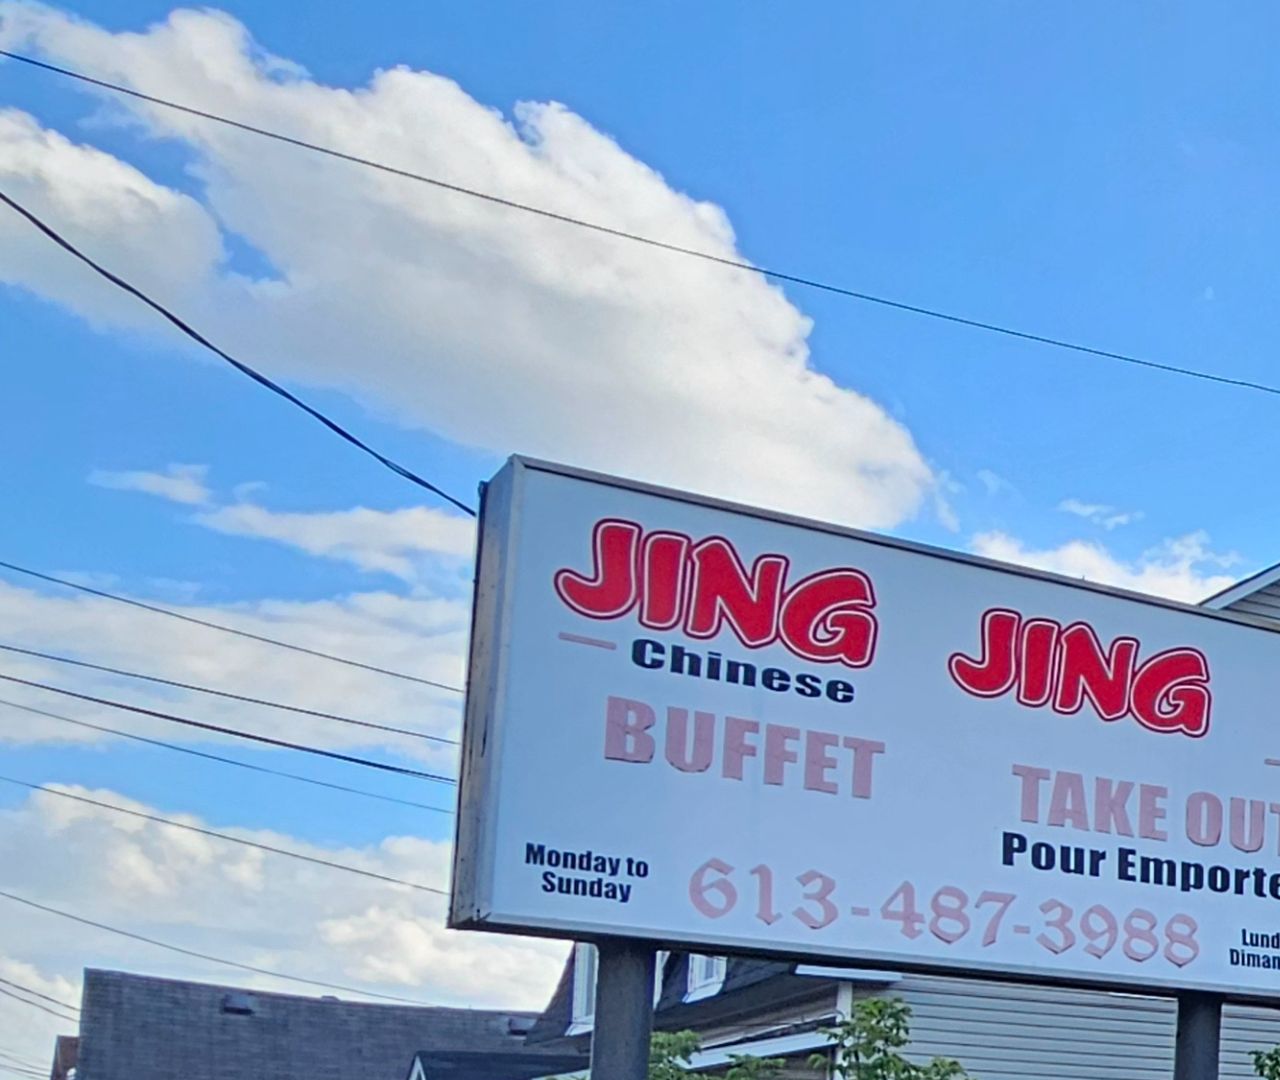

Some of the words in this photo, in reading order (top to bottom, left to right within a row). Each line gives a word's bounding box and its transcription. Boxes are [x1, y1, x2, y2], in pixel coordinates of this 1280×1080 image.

[554, 518, 877, 669] JING
[631, 638, 855, 703] Chinese
[949, 607, 1211, 738] JING
[604, 695, 886, 800] BUFFET
[1011, 763, 1168, 842] TAKE
[525, 841, 621, 877] Monday
[626, 857, 649, 879] to
[541, 870, 632, 904] Sunday
[1001, 830, 1107, 878] Pour
[688, 856, 1200, 968] 613-487-3988
